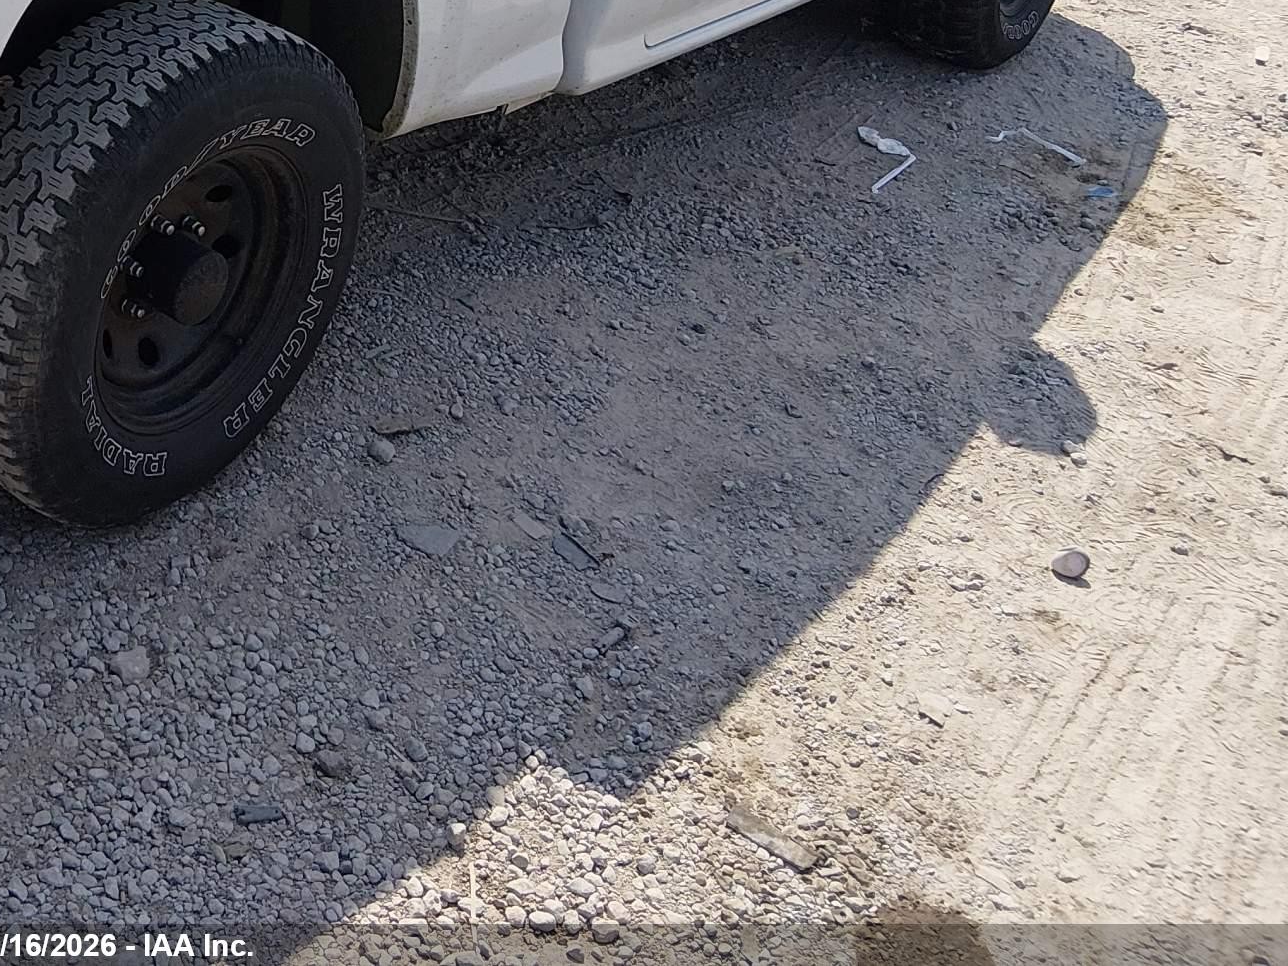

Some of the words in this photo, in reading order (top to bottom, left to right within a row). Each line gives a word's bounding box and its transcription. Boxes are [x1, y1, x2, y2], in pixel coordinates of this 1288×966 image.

[100, 118, 317, 299] GOODYEAR
[222, 183, 344, 438] WRANGLER
[80, 375, 168, 477] RADIAL
